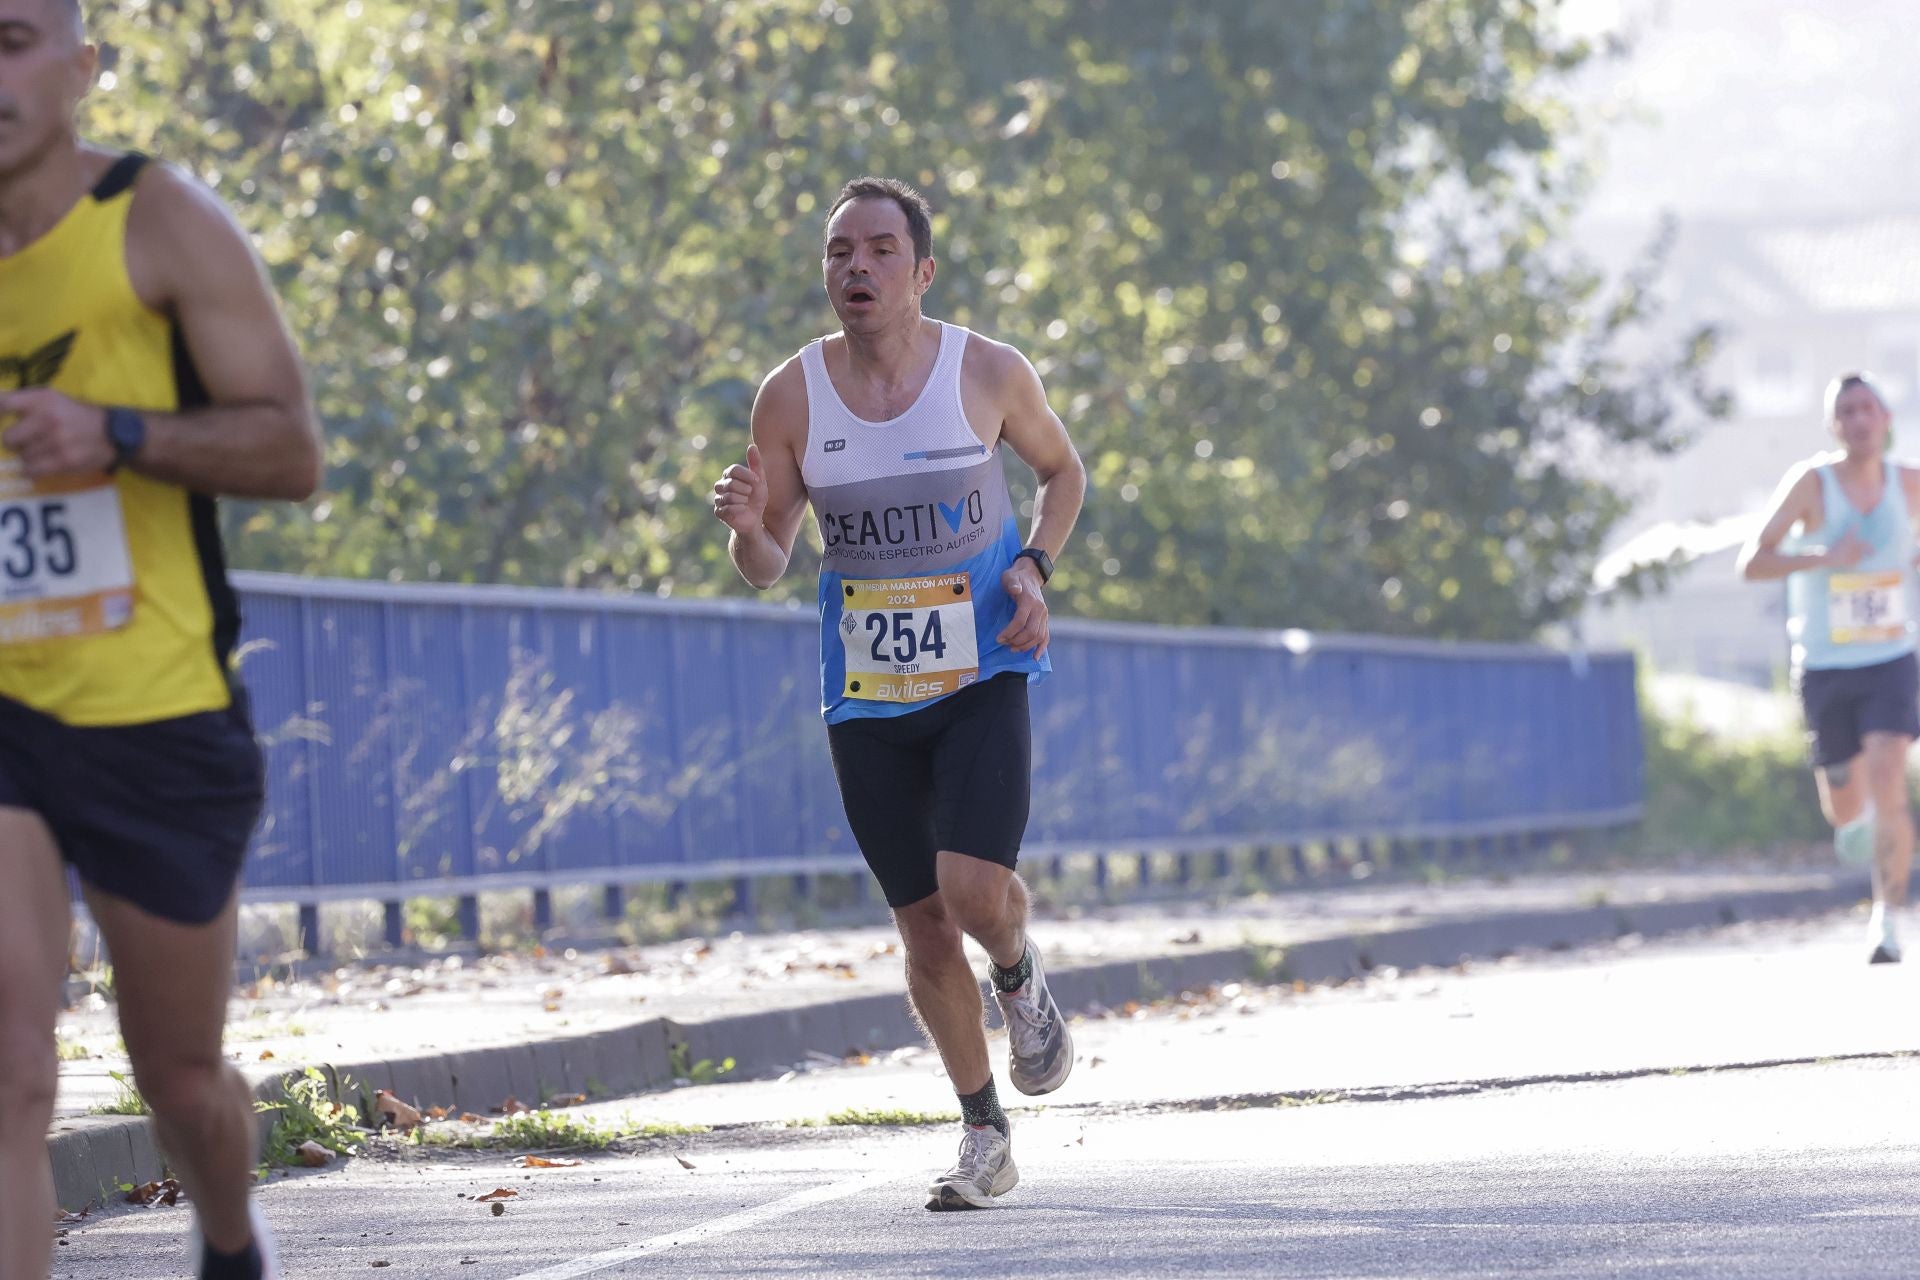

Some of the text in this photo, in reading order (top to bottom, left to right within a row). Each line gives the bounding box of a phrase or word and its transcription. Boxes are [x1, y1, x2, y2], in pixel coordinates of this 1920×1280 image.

[879, 543, 943, 560] ESPECTRO
[946, 526, 985, 551] AUTISTA
[866, 583, 888, 592] MEDIA
[890, 579, 934, 591] MARATÓN
[938, 575, 966, 587] AVILÉS
[887, 594, 916, 605] 2024
[866, 610, 946, 663] 254
[893, 663, 920, 674] SPEEDY
[877, 680, 944, 698] avilés
